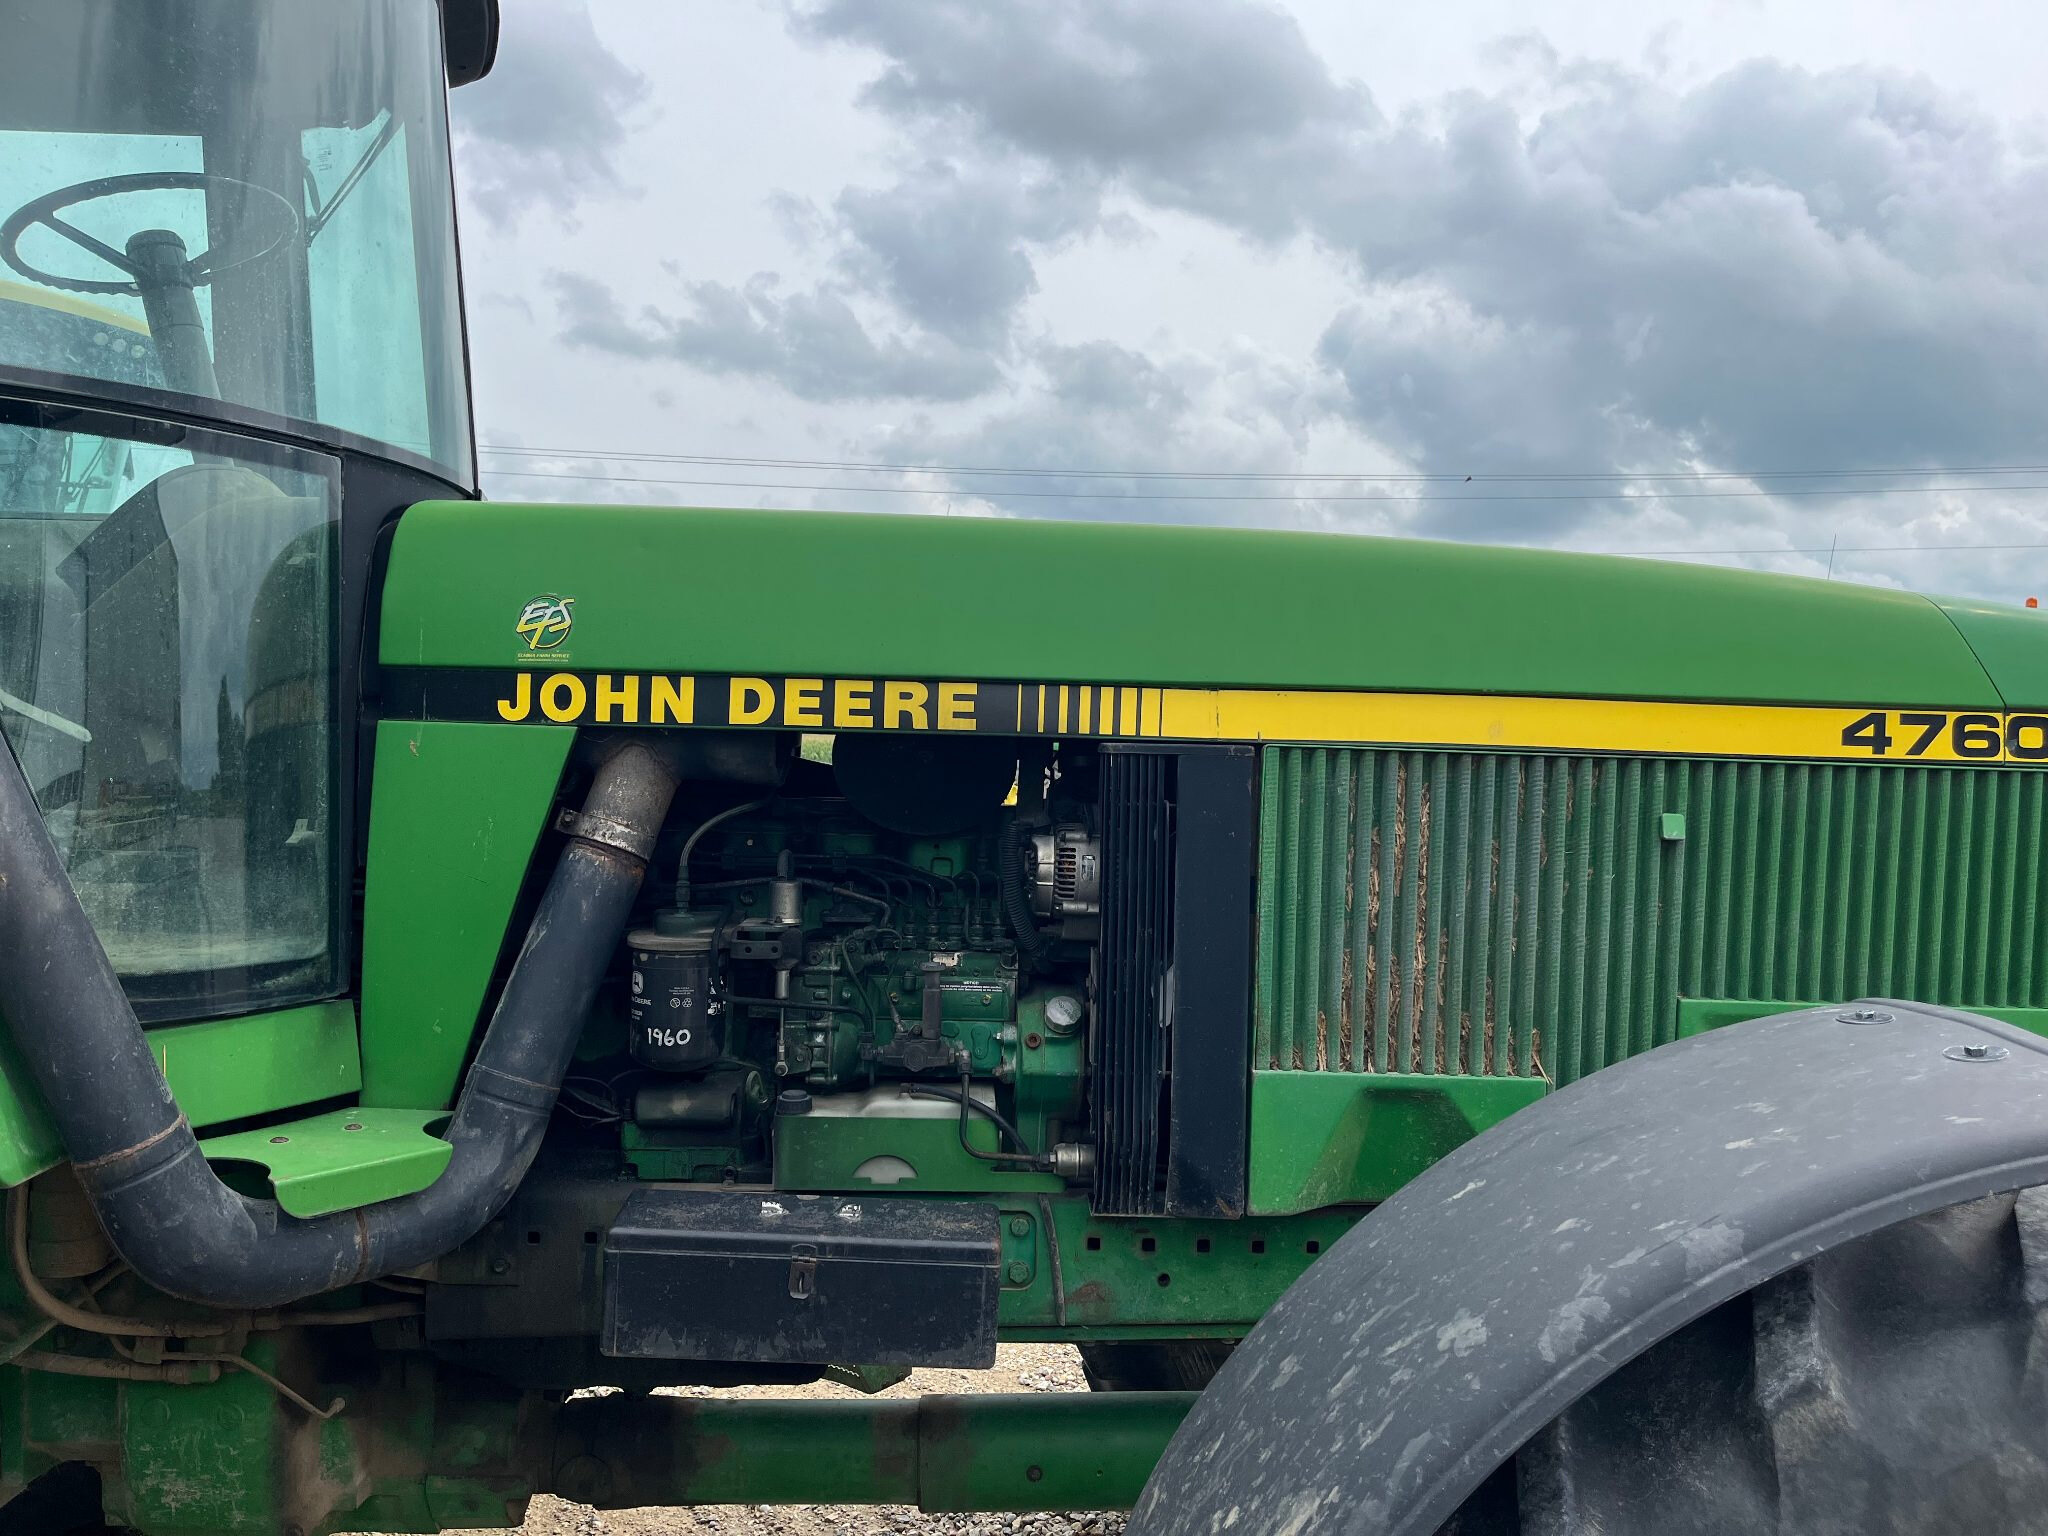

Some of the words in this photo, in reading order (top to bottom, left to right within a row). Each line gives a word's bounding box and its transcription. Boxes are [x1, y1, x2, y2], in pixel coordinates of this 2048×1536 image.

[497, 673, 695, 723] JOHN
[728, 677, 978, 731] DEERE
[1841, 712, 2048, 760] 4760
[647, 1027, 692, 1047] 1960
